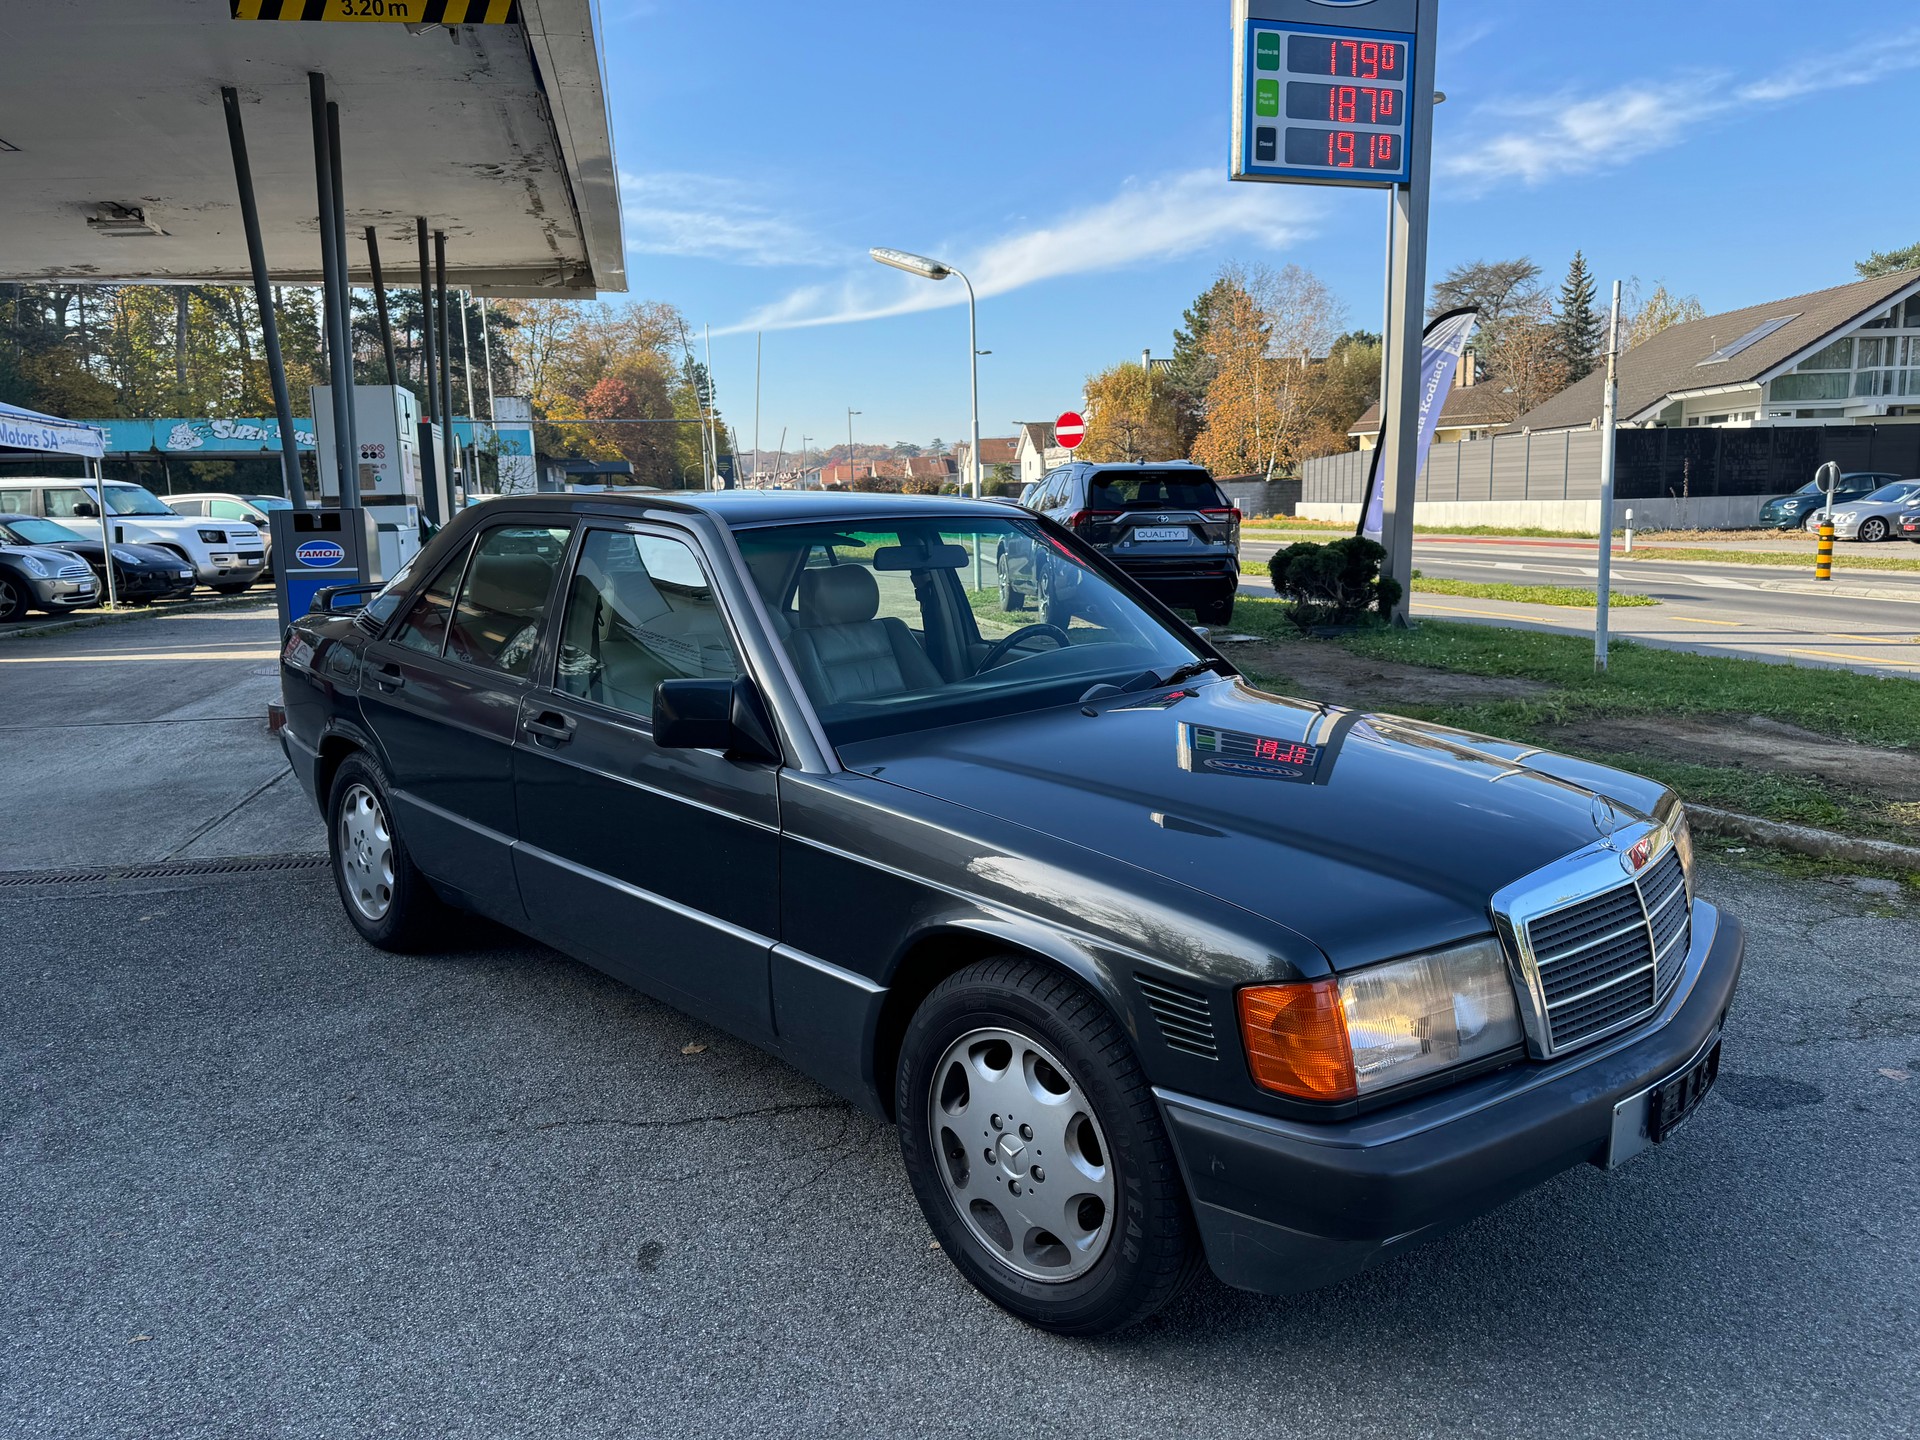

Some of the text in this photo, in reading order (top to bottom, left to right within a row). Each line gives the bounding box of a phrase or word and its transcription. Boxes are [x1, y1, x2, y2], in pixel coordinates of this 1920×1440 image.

[341, 0, 408, 17] 3.20 m
[1420, 360, 1448, 415] Kodiaq
[0, 422, 39, 448] Motors
[42, 429, 59, 450] SA
[1137, 530, 1179, 539] QUALITY
[297, 550, 343, 558] TAMOIL
